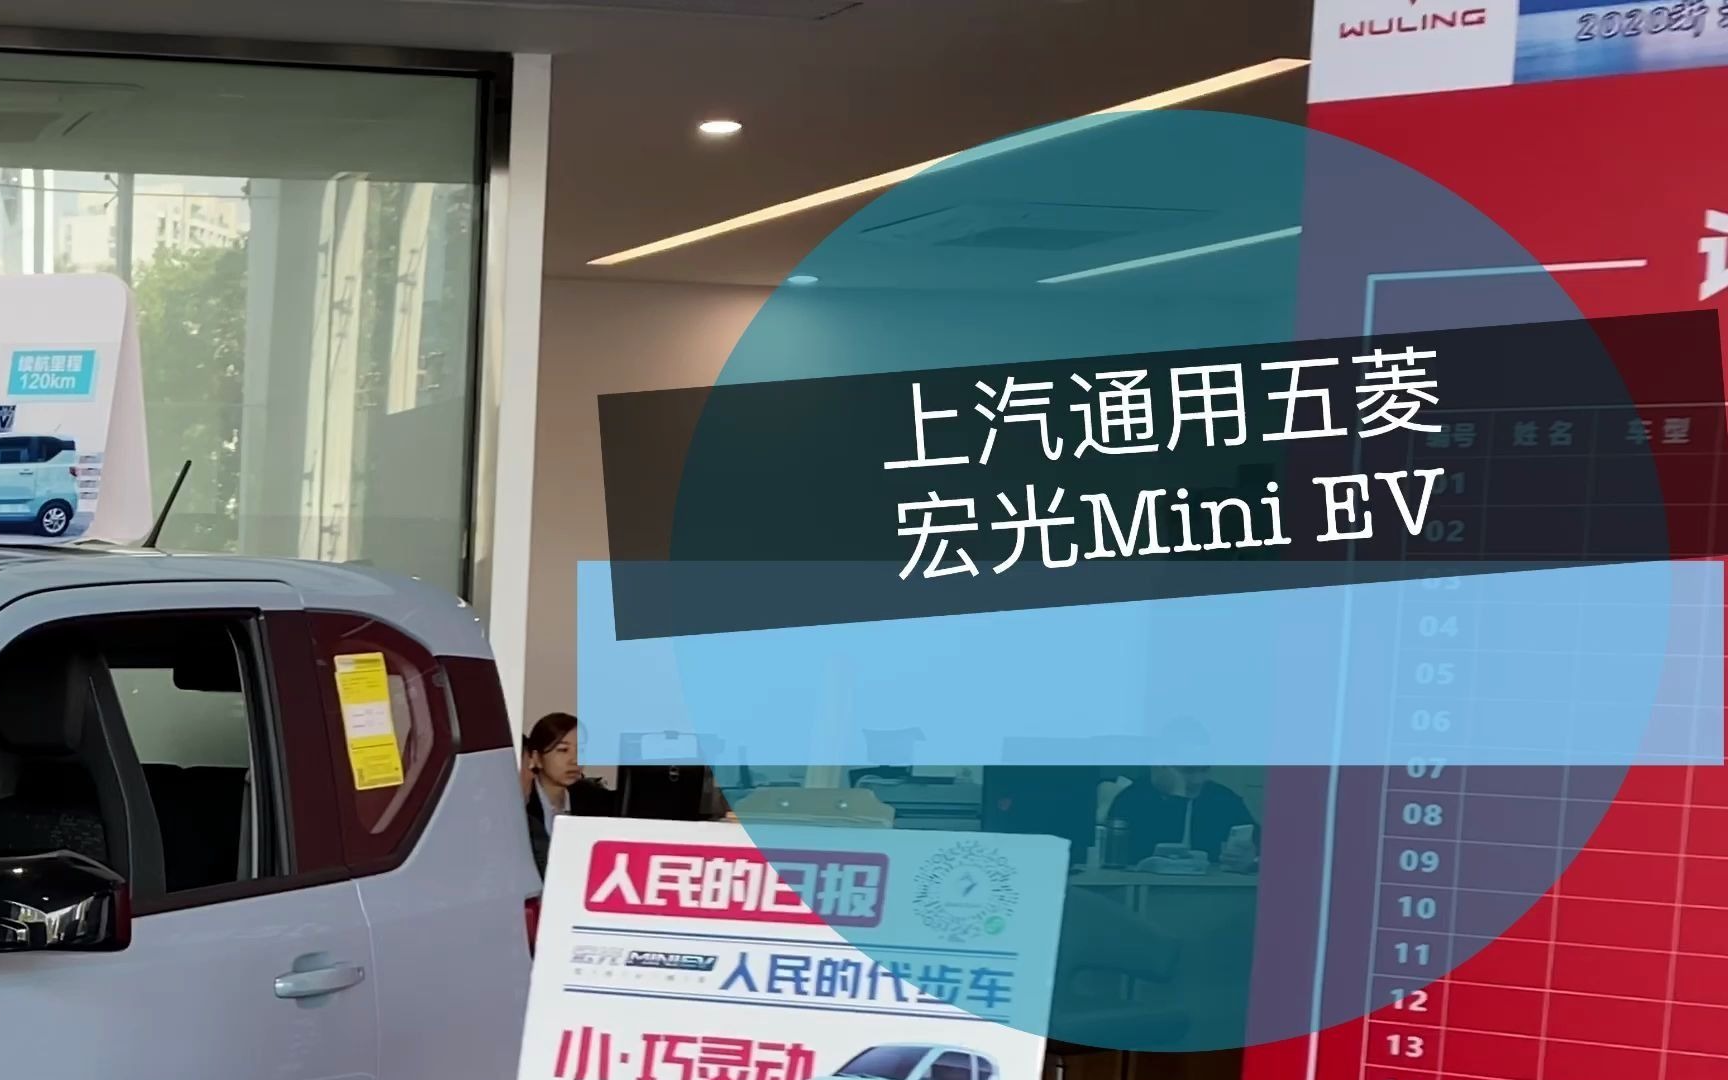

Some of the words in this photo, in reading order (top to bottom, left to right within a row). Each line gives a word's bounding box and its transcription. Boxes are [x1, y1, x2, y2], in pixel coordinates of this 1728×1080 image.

[1339, 9, 1487, 38] WULING
[17, 353, 83, 374] 续航里程
[19, 372, 76, 391] 120km
[1512, 419, 1575, 448] 姓名
[1624, 416, 1692, 445] 车型
[1424, 519, 1466, 543] 02
[1418, 616, 1459, 638] 04
[1415, 663, 1455, 685] 05
[1411, 710, 1451, 732] 06
[1407, 757, 1447, 779] 07
[1403, 803, 1443, 826] 08
[1399, 850, 1440, 873] 09
[589, 854, 881, 919] 人民的日报
[1397, 896, 1436, 919] 10
[1394, 942, 1430, 966] 11
[719, 952, 1013, 1009] 人民的代步车
[1390, 988, 1428, 1012] 12
[1386, 1034, 1424, 1058] 13
